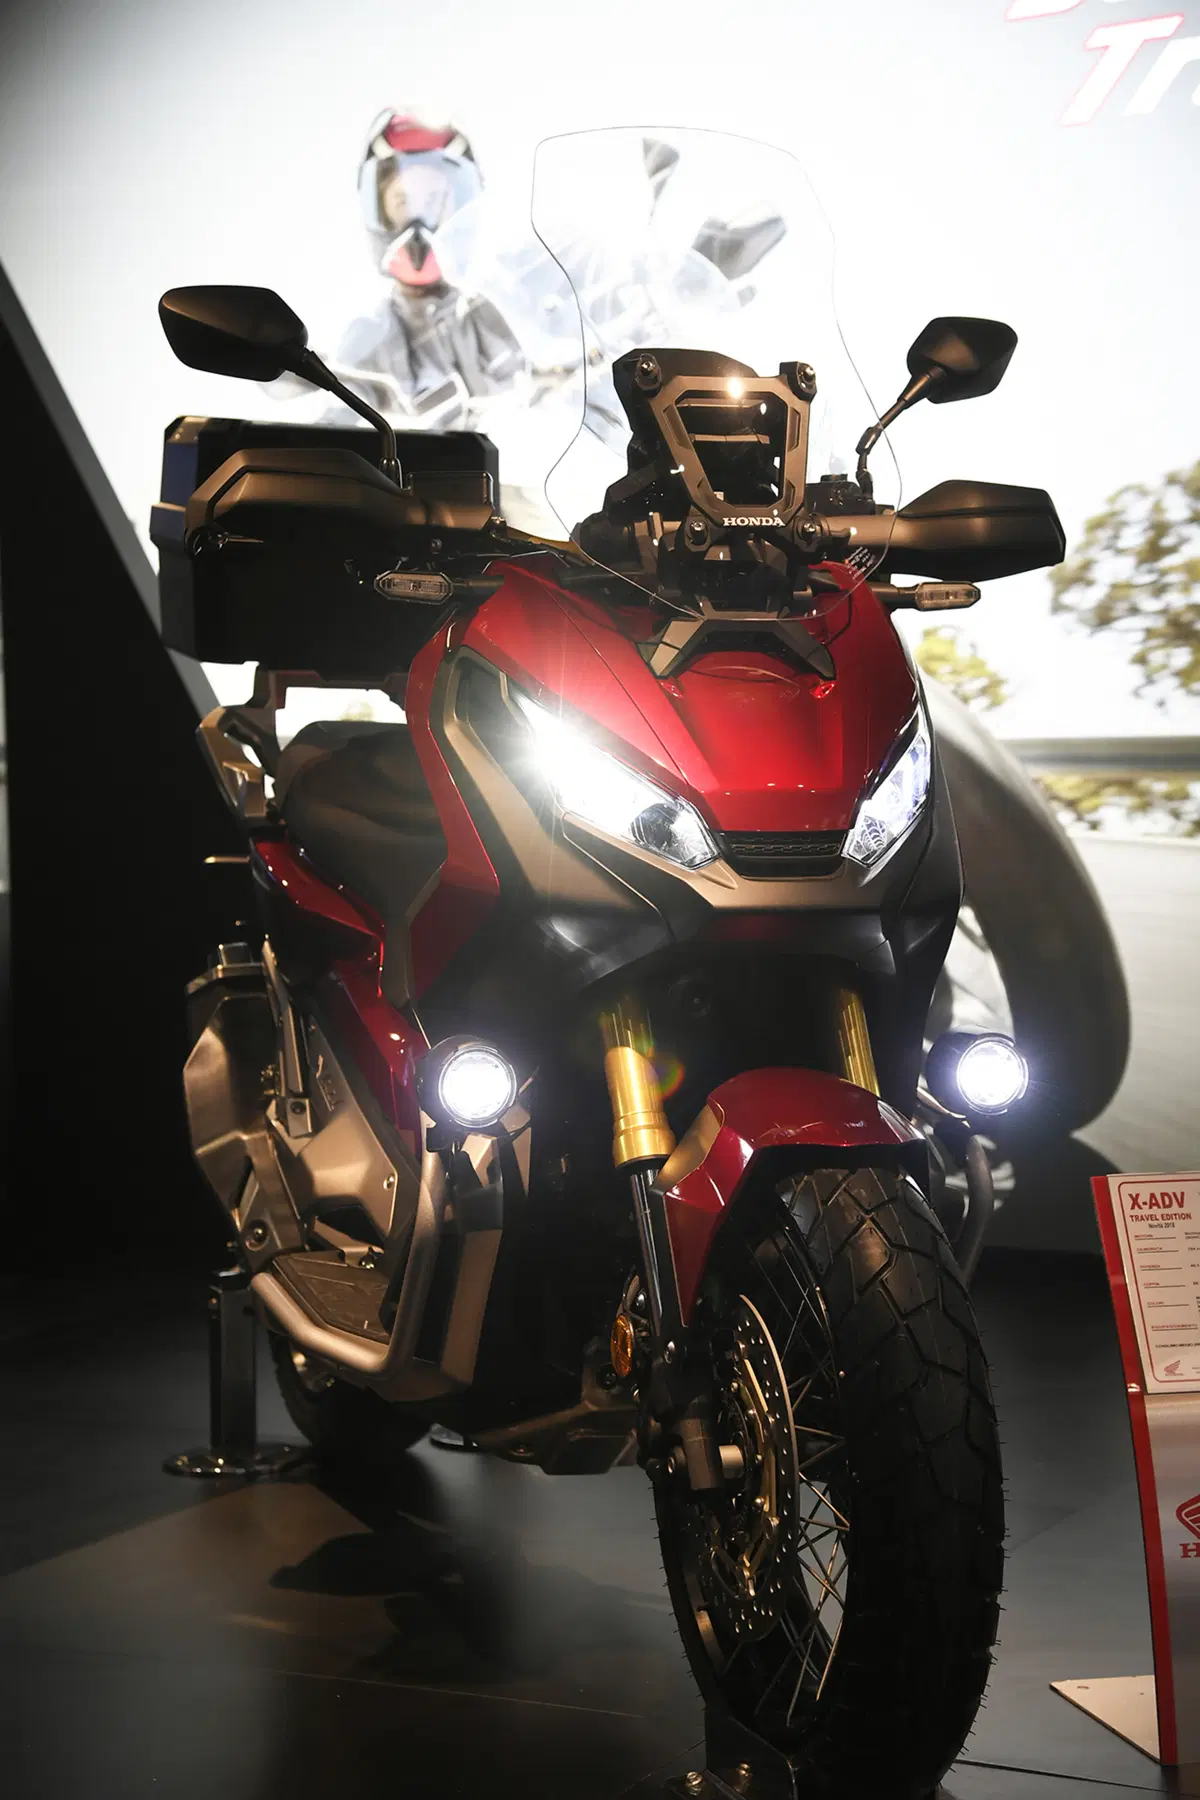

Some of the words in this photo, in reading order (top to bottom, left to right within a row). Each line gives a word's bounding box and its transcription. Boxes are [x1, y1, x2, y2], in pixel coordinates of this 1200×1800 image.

[722, 517, 785, 527] HONDA
[1128, 1191, 1185, 1210] X-ADV
[1129, 1214, 1159, 1222] TRAVEL
[1161, 1212, 1192, 1221] EDITION
